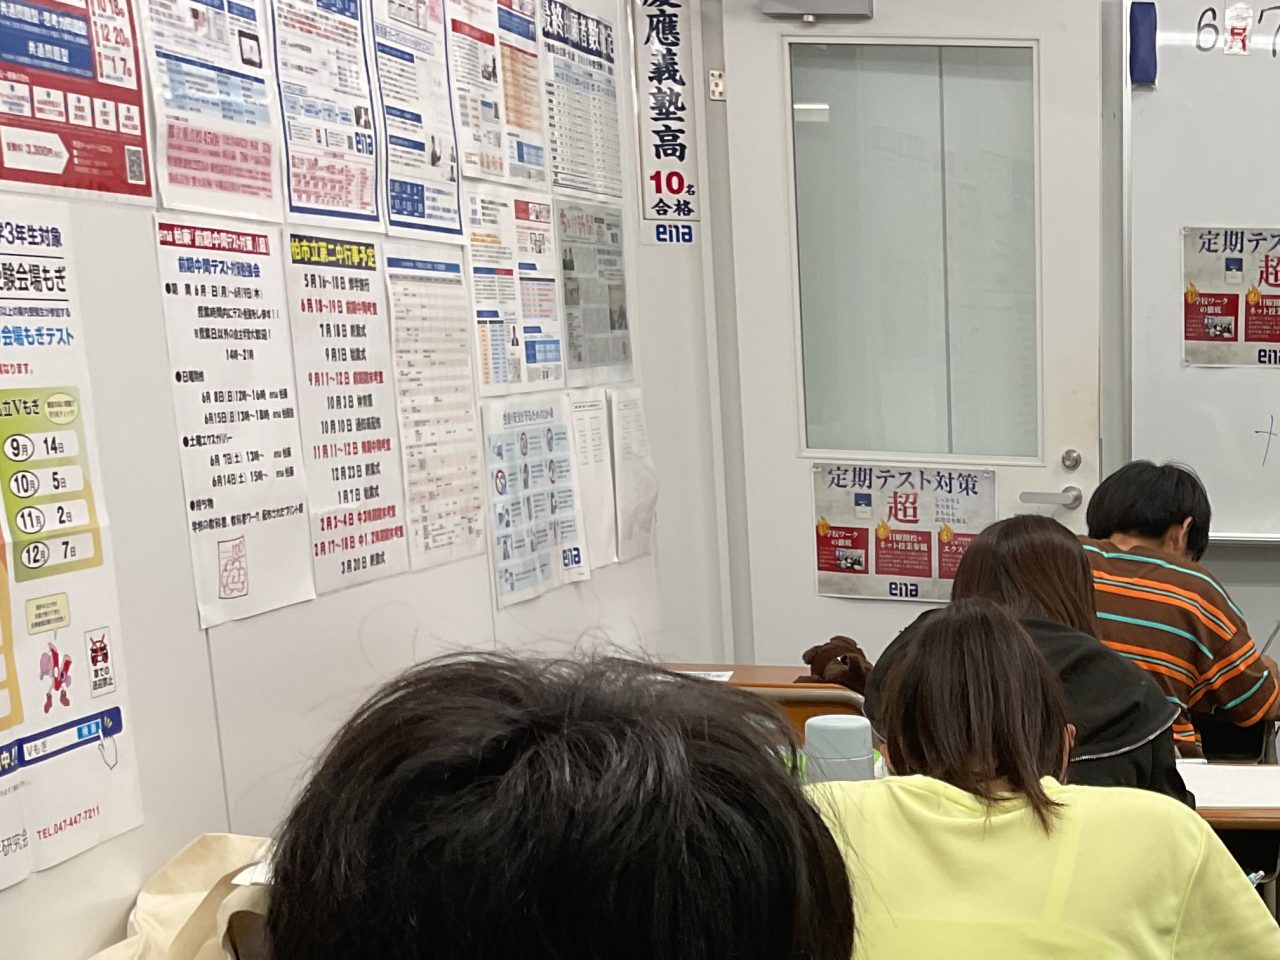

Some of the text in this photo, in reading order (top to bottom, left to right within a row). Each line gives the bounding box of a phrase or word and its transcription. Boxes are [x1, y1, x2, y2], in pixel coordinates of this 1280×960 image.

[643, 0, 688, 163] 應義塾高
[355, 132, 374, 156] ena
[651, 197, 695, 216] 合格
[656, 224, 693, 243] ena
[0, 262, 67, 293] 験会場もぎ
[0, 399, 40, 417] 立Vもぎ
[10, 436, 65, 457] 9月 14日
[14, 471, 67, 494] 10月 5日
[827, 466, 979, 496] 定期テスト対策
[20, 506, 73, 530] 11月 2日
[886, 491, 920, 524] 超
[25, 541, 77, 565] 12月 7日
[888, 581, 919, 598] ena
[0, 745, 18, 770] 中!!
[36, 805, 101, 841] TEL.047-447-7211
[0, 828, 28, 857] 研究会
